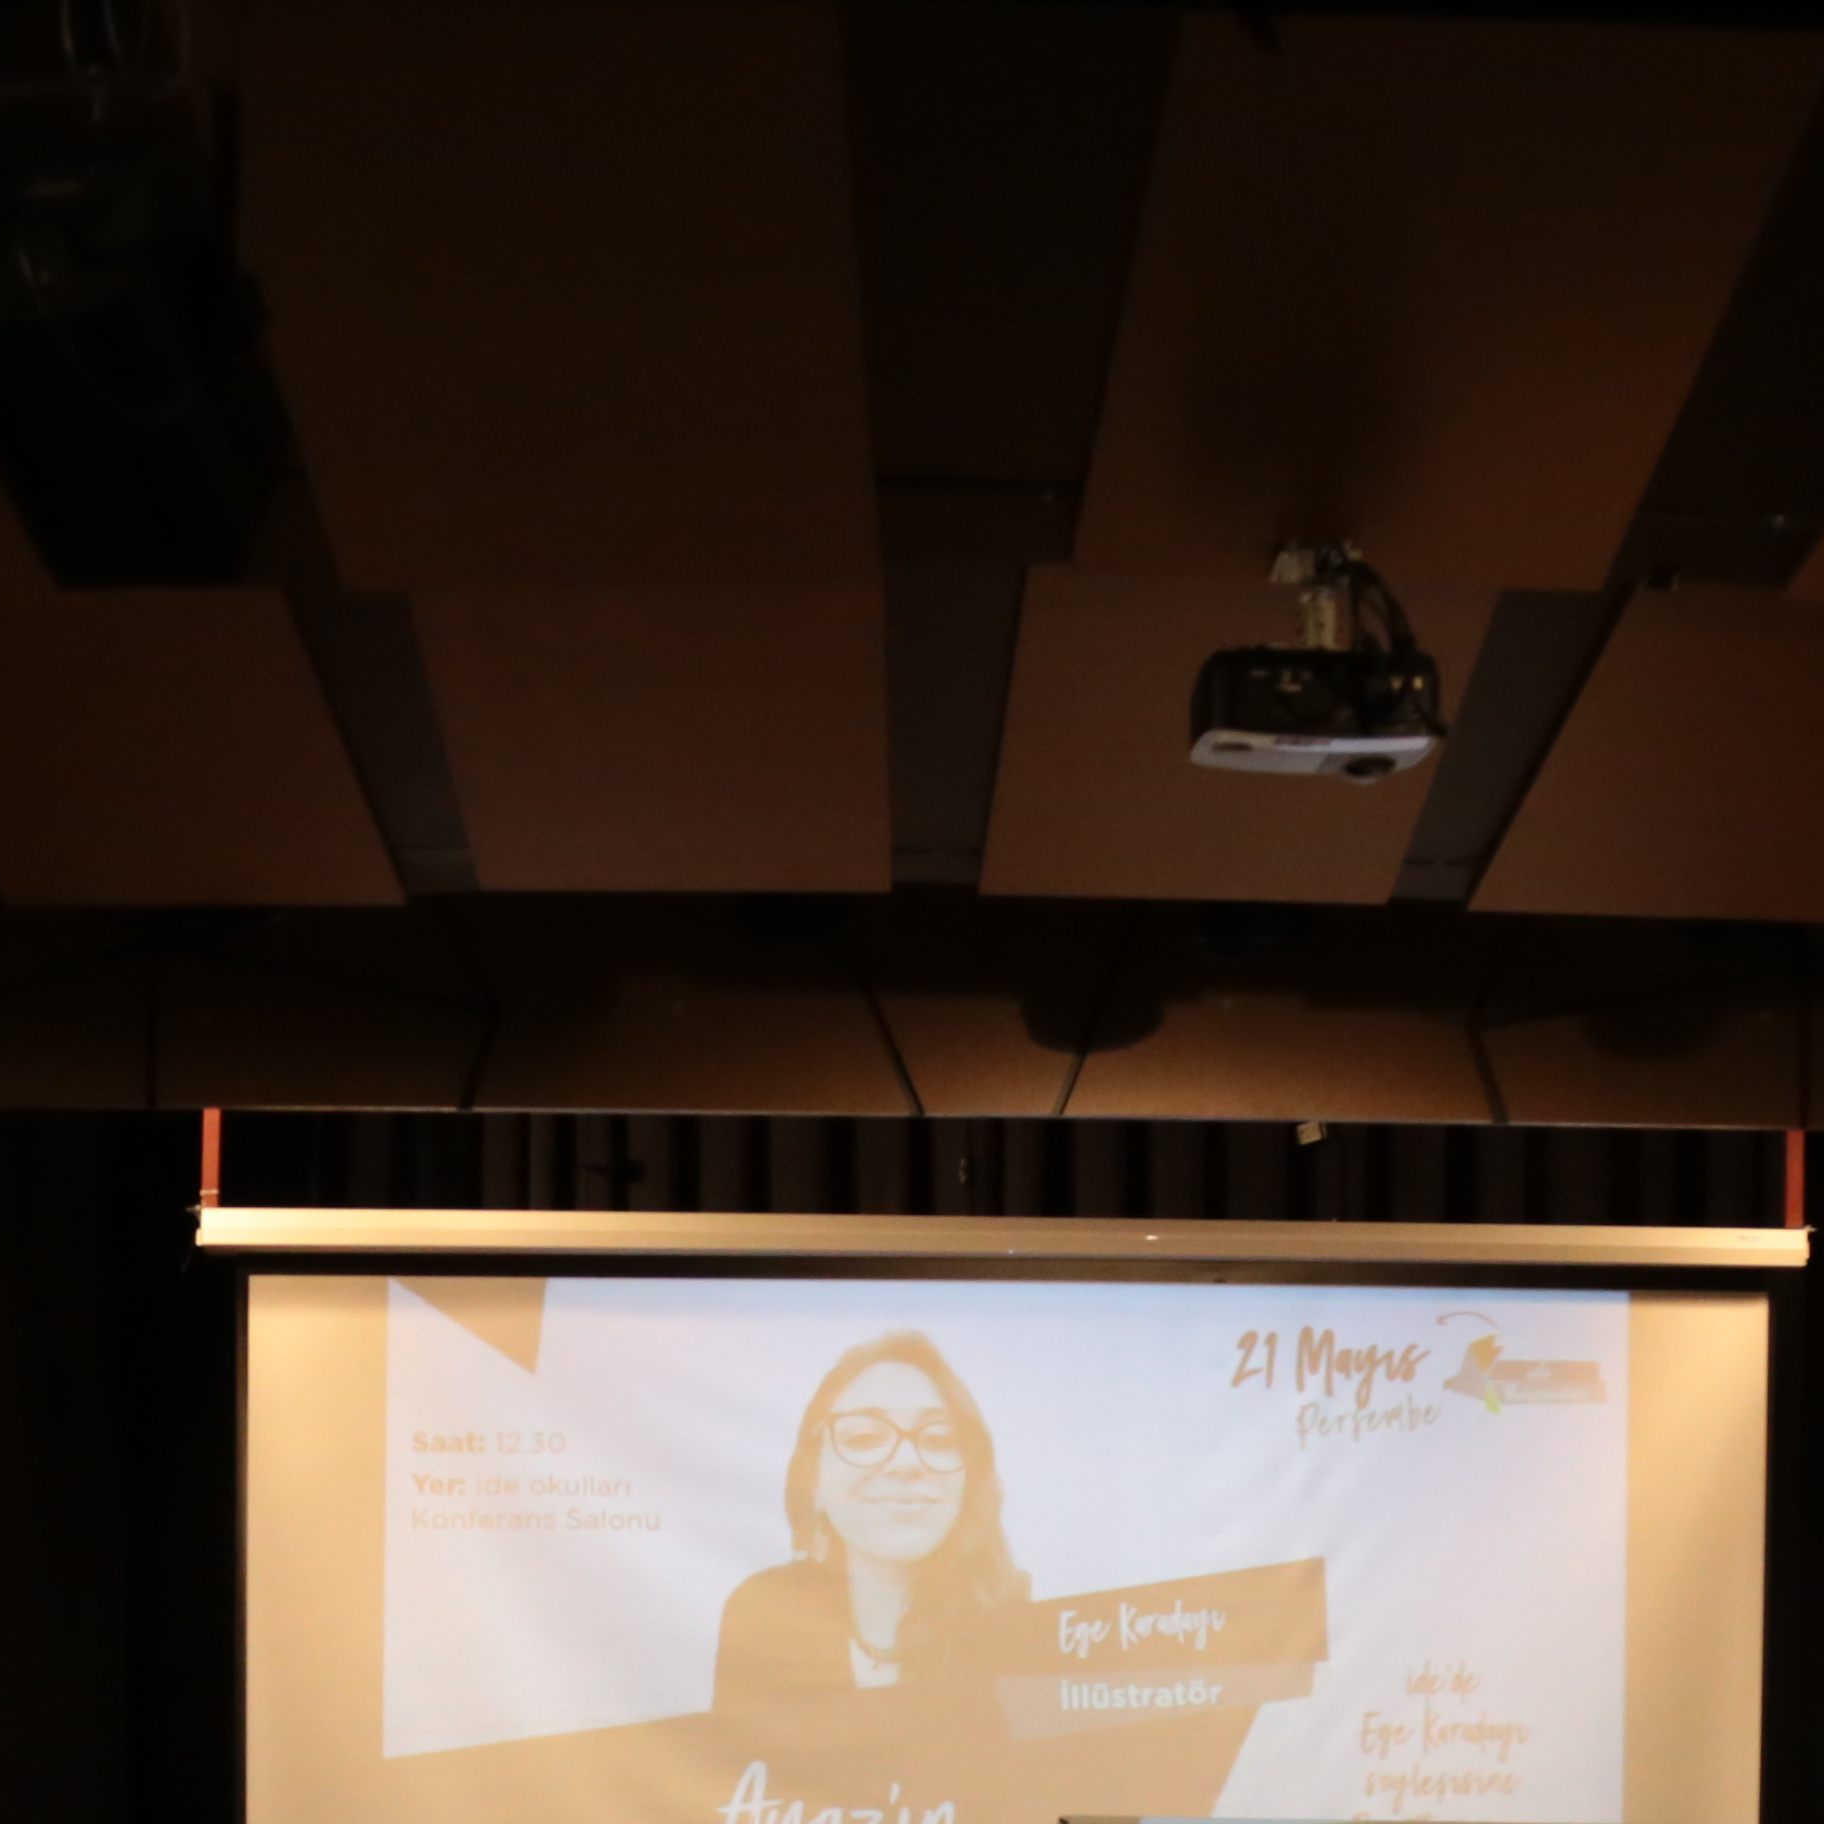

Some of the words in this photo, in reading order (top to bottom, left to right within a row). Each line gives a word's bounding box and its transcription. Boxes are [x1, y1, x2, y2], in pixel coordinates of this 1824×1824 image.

[1231, 1329, 1279, 1390] 21
[411, 1430, 487, 1454] Saat:
[411, 1473, 466, 1496] Yer:
[475, 1474, 520, 1496] ide
[528, 1474, 632, 1496] okulları
[411, 1507, 557, 1531] Konferans
[565, 1508, 661, 1531] Salonu
[1058, 1609, 1113, 1659] Ege
[1360, 1710, 1415, 1761] Ege
